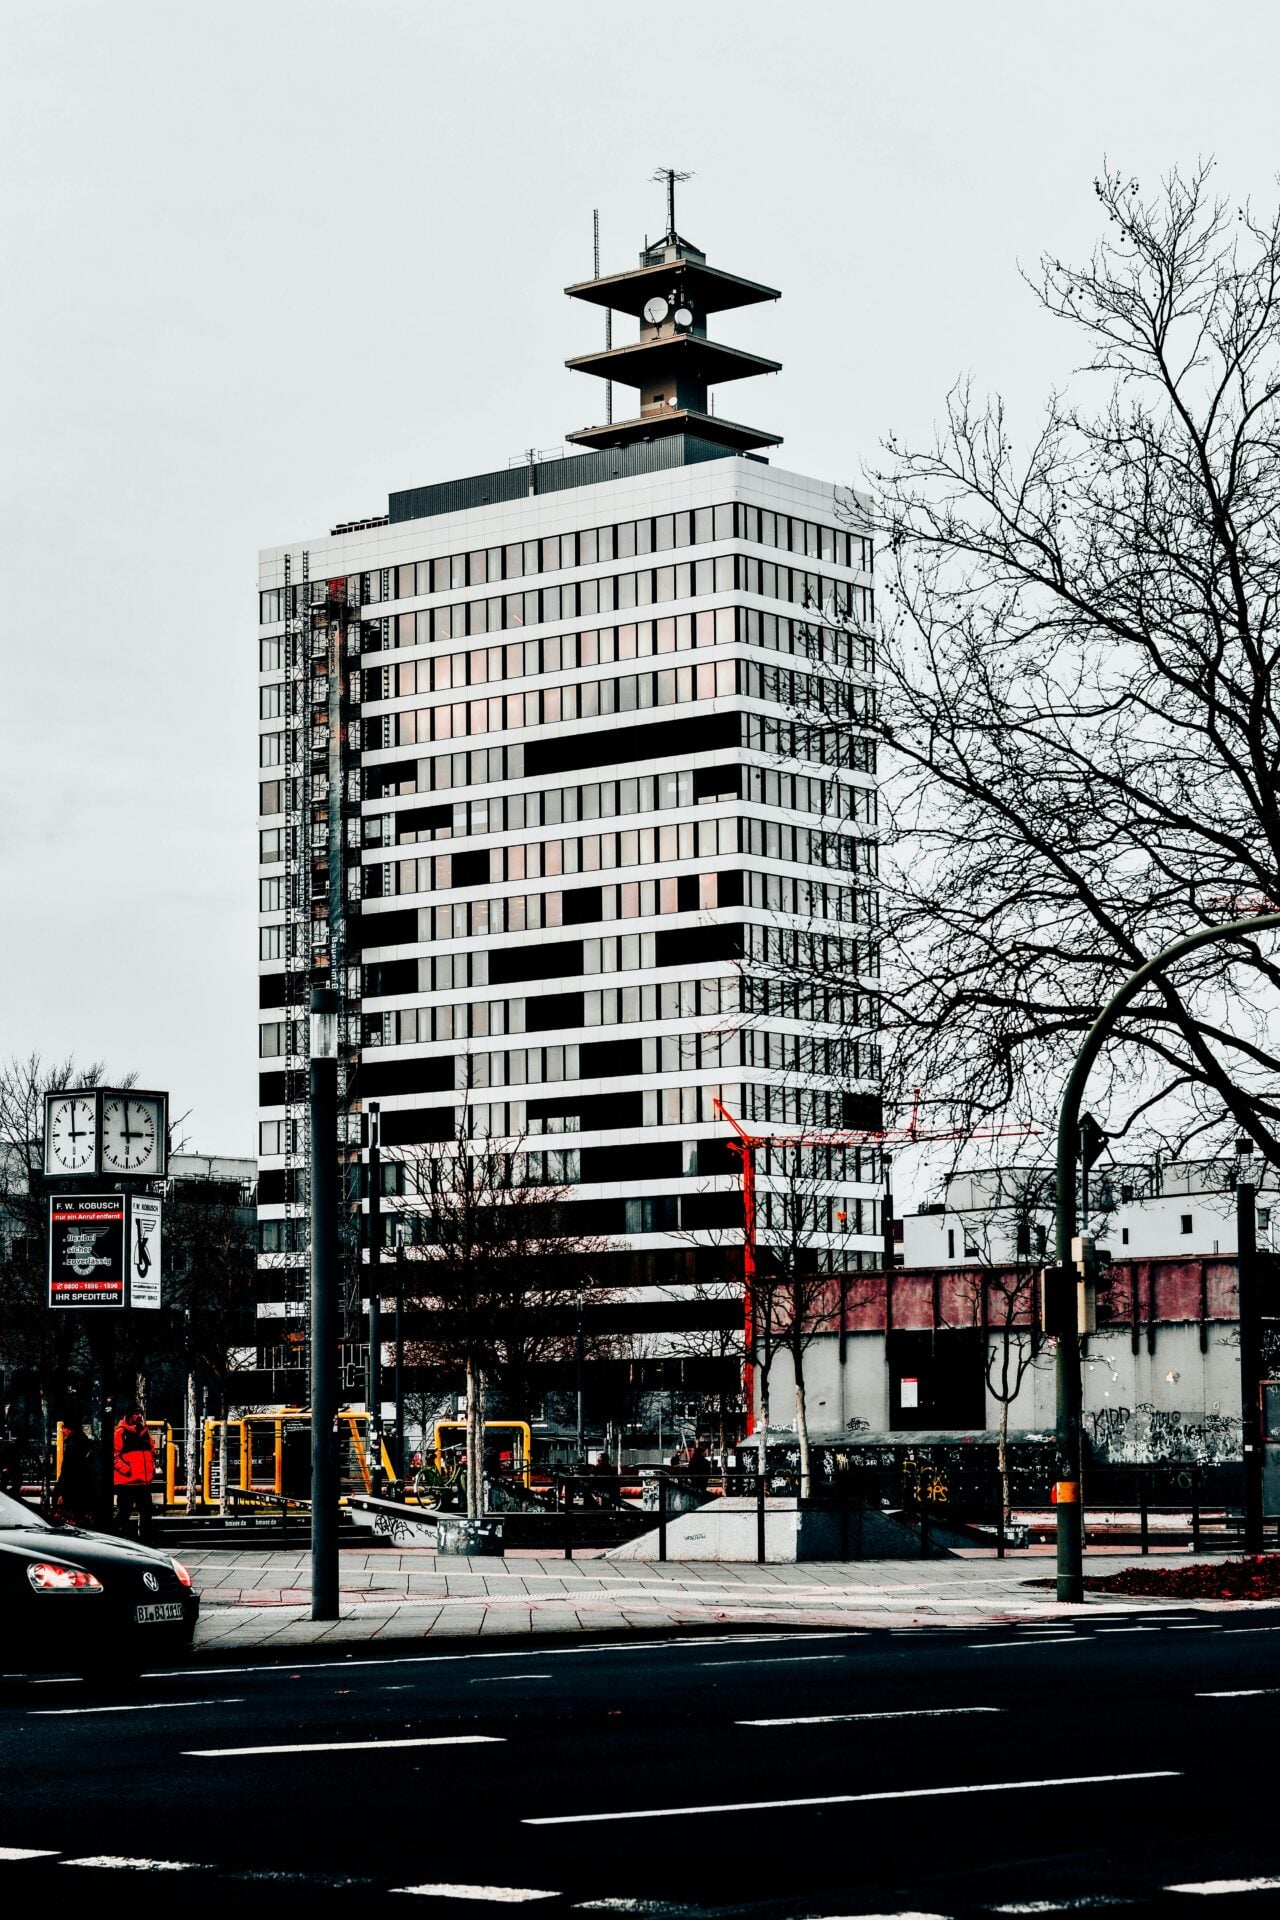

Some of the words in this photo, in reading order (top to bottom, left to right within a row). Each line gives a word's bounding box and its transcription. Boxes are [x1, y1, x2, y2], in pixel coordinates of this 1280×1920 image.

[331, 936, 339, 966] Bauen
[331, 968, 339, 980] im
[56, 1202, 63, 1210] F.
[64, 1202, 75, 1210] W.
[55, 1293, 70, 1301] IHR
[71, 1292, 118, 1300] SPEDITEUR
